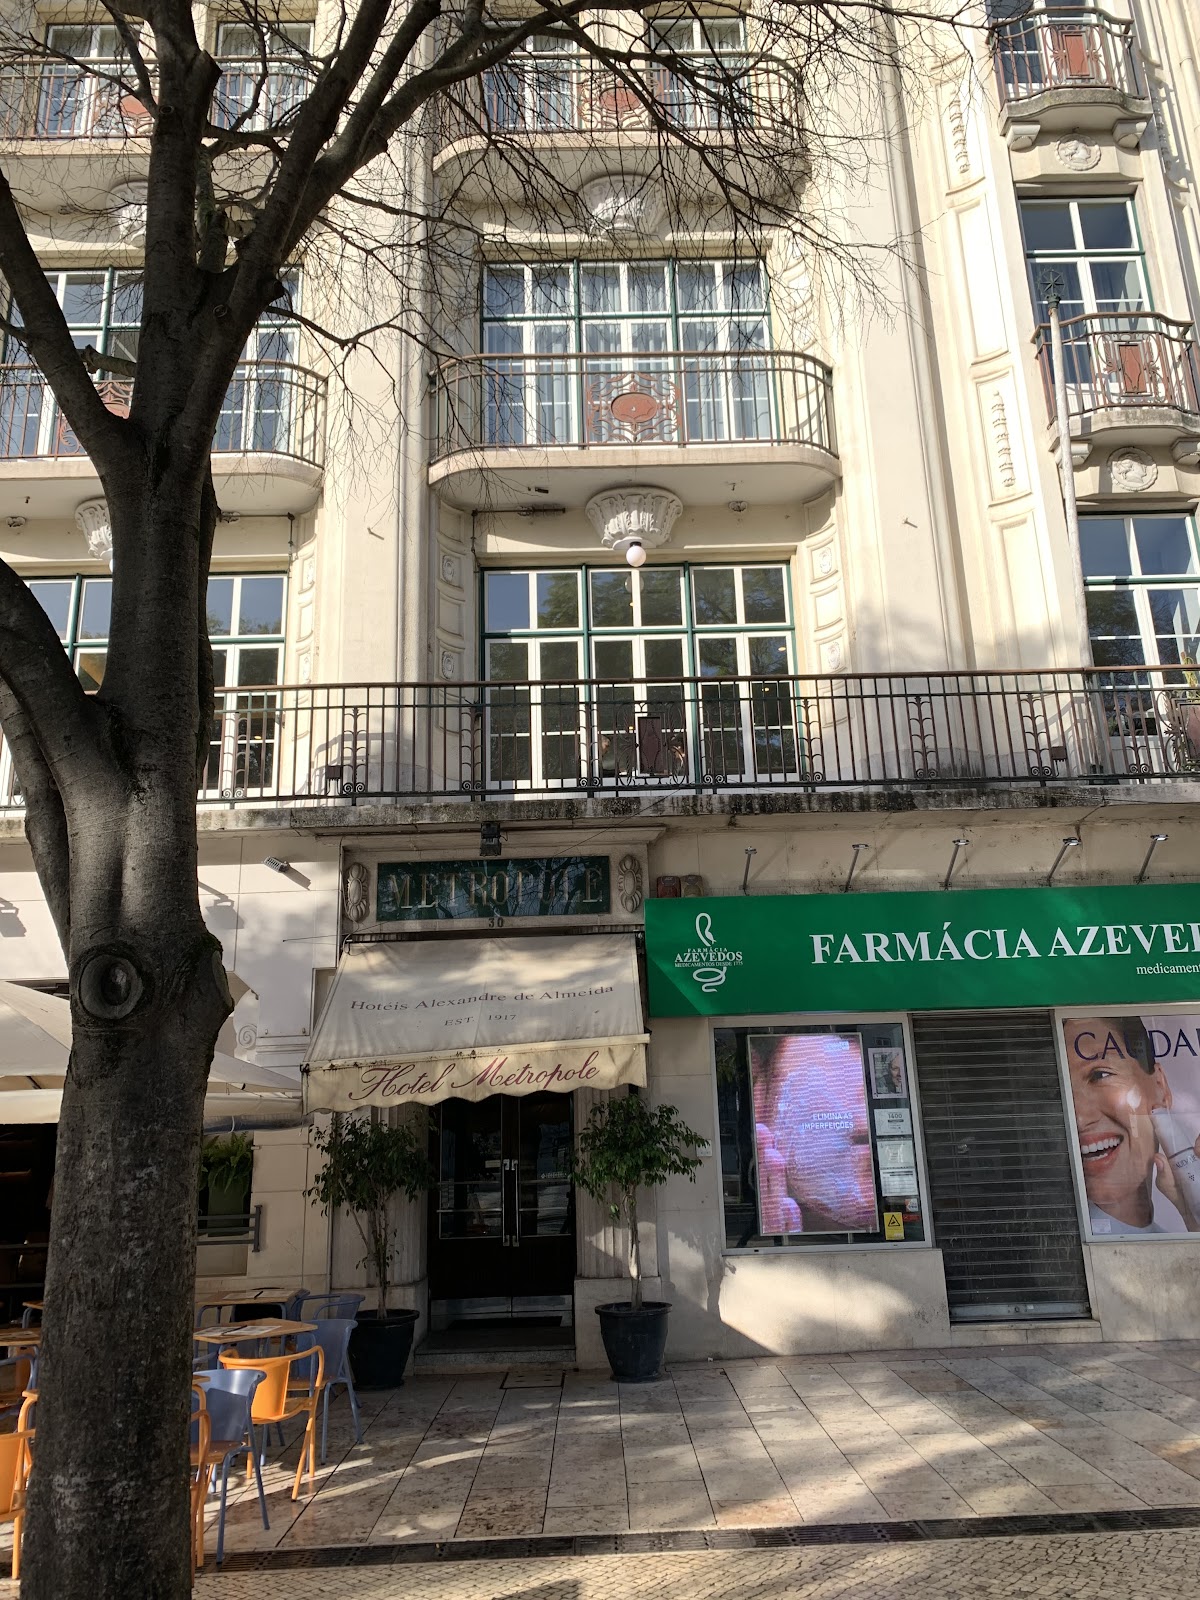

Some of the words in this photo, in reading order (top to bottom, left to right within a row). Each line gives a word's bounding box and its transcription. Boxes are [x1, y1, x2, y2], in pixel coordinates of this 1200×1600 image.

[488, 917, 504, 928] 30
[809, 922, 1042, 964] FARMÁCIA
[674, 951, 743, 963] AZEVEDOS
[350, 1000, 408, 1011] Hotéis
[415, 992, 506, 1009] Alexandre
[514, 992, 534, 1001] de
[539, 986, 613, 1000] Almeida
[444, 1016, 475, 1026] EST.
[348, 1063, 456, 1101] Hotel
[812, 1112, 842, 1121] ELIMINA
[843, 1112, 853, 1120] AS
[802, 1121, 854, 1131] IMPERFEIÇÕES
